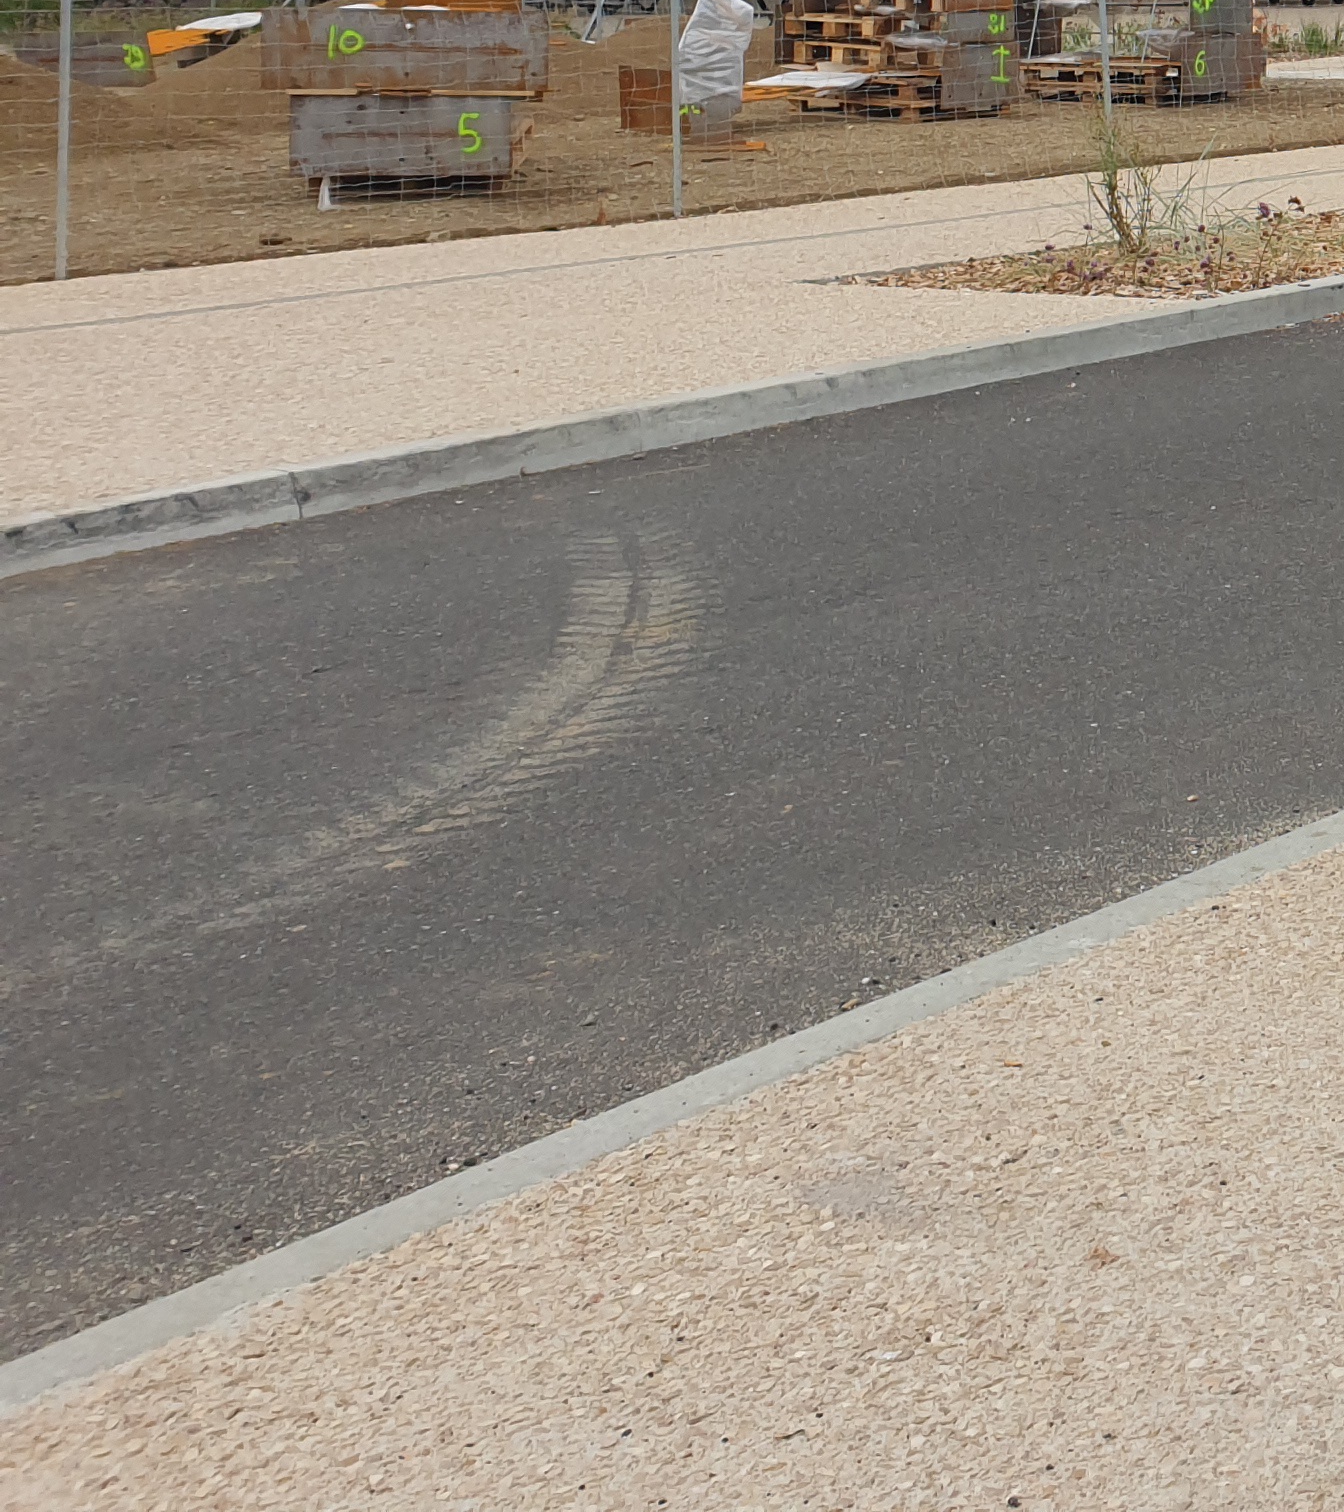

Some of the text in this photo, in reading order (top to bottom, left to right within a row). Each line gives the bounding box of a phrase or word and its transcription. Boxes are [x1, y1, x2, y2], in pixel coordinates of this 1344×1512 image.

[328, 24, 365, 60] 10
[1195, 50, 1206, 77] 6
[458, 113, 482, 153] 5
